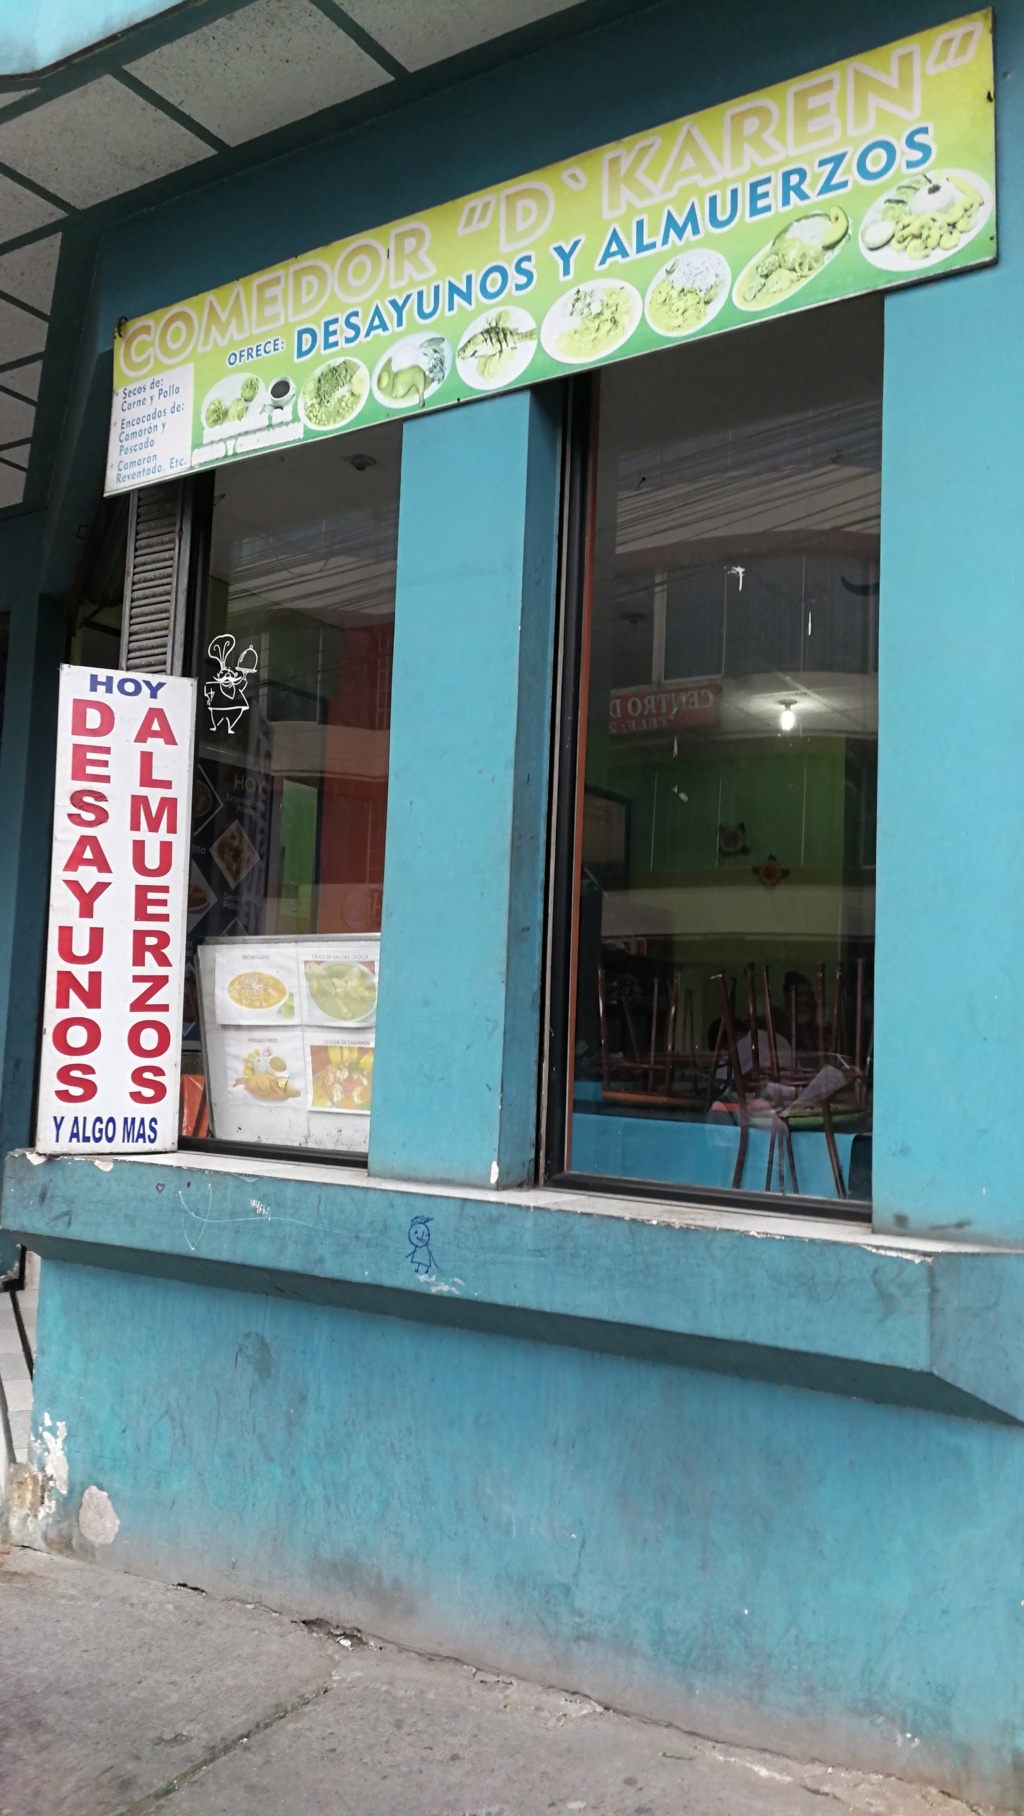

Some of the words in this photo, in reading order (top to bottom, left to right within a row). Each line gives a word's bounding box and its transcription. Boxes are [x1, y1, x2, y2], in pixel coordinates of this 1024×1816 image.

[227, 339, 285, 366] OFRECE:
[296, 254, 535, 360] DESAYUNOS
[553, 240, 581, 278] Y
[600, 126, 934, 267] ALMUERZOS
[119, 221, 435, 377] COMEDOR
[121, 398, 147, 412] Carne
[149, 394, 155, 406] y
[157, 384, 180, 400] Pollo
[122, 384, 147, 400] Secos
[149, 378, 164, 390] de:
[120, 407, 167, 430] Encocados
[170, 401, 185, 414] de:
[161, 421, 166, 433] y
[119, 436, 155, 456] Pescado
[169, 456, 187, 470] Etc.
[89, 673, 167, 700] HOY
[234, 773, 265, 795] HOY
[52, 698, 116, 1105] DESAYUNOS
[127, 707, 179, 1105] ALMUERZOS
[53, 1116, 65, 1142] Y
[69, 1116, 117, 1143] ALGO
[121, 1117, 158, 1144] MAS
